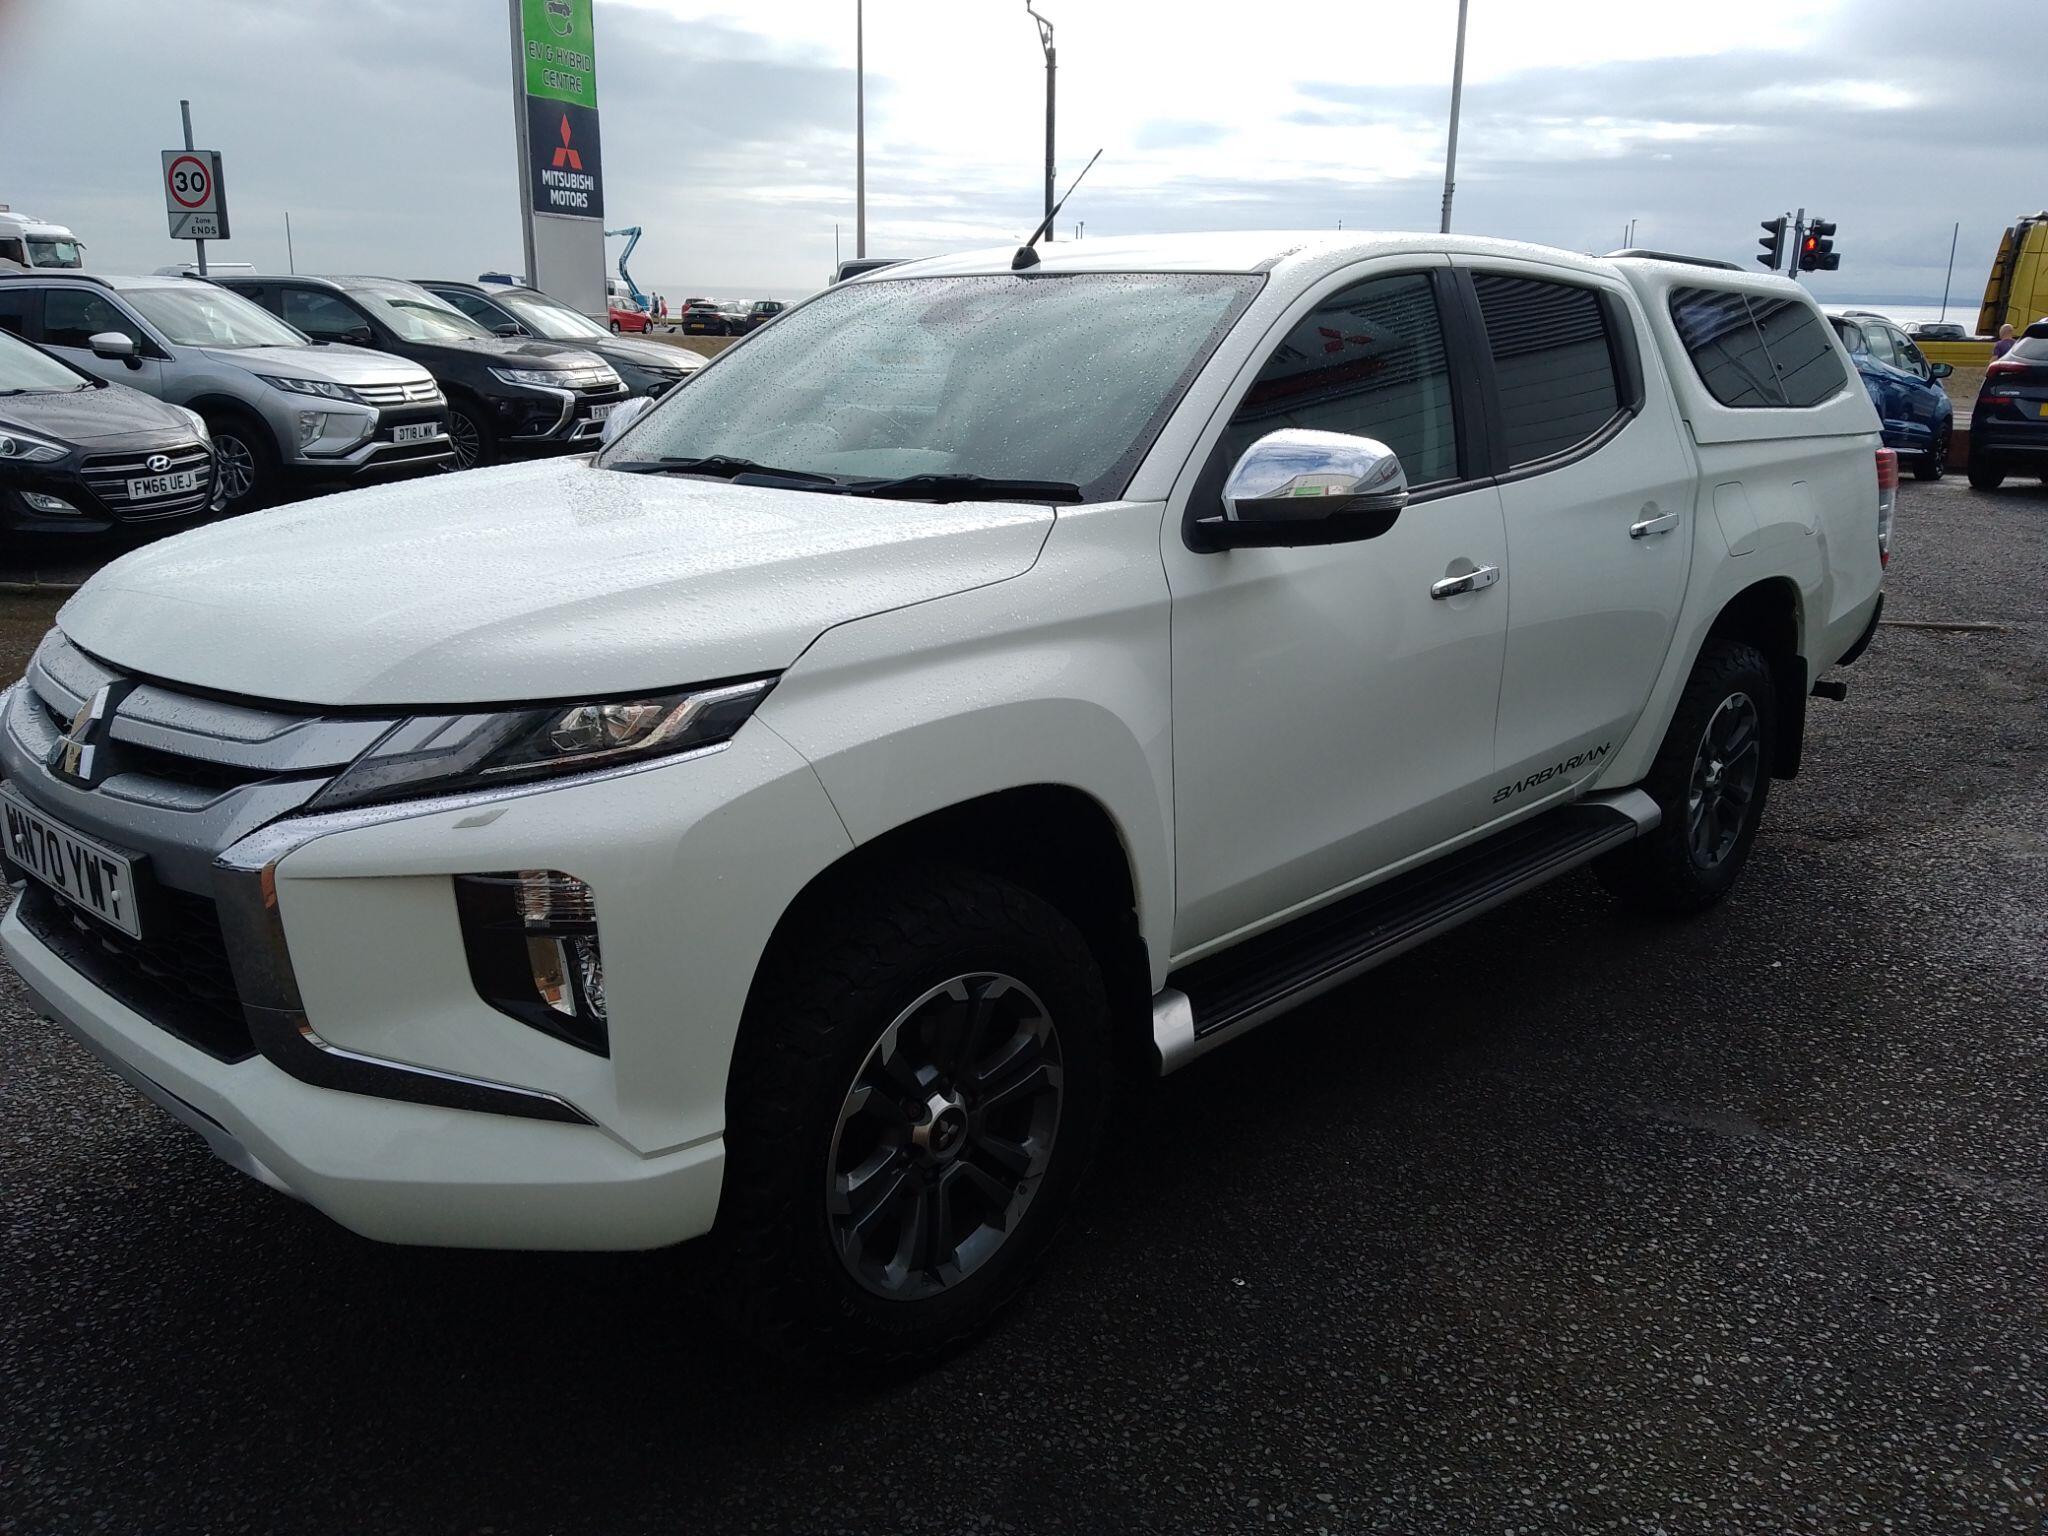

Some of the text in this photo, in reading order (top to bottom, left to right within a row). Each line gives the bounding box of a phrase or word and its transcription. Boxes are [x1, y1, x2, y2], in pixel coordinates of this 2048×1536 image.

[528, 41, 592, 72] EV & HYBRID
[542, 69, 583, 94] CENTRE
[174, 171, 205, 192] 30
[541, 169, 594, 191] MITSUBISHI
[550, 189, 588, 208] MOTORS
[191, 226, 217, 235] ENDS
[194, 216, 211, 224] Zone
[399, 427, 417, 440] DT18
[134, 473, 192, 496] FM66 UEJ
[1492, 742, 1611, 804] BARBARIAN
